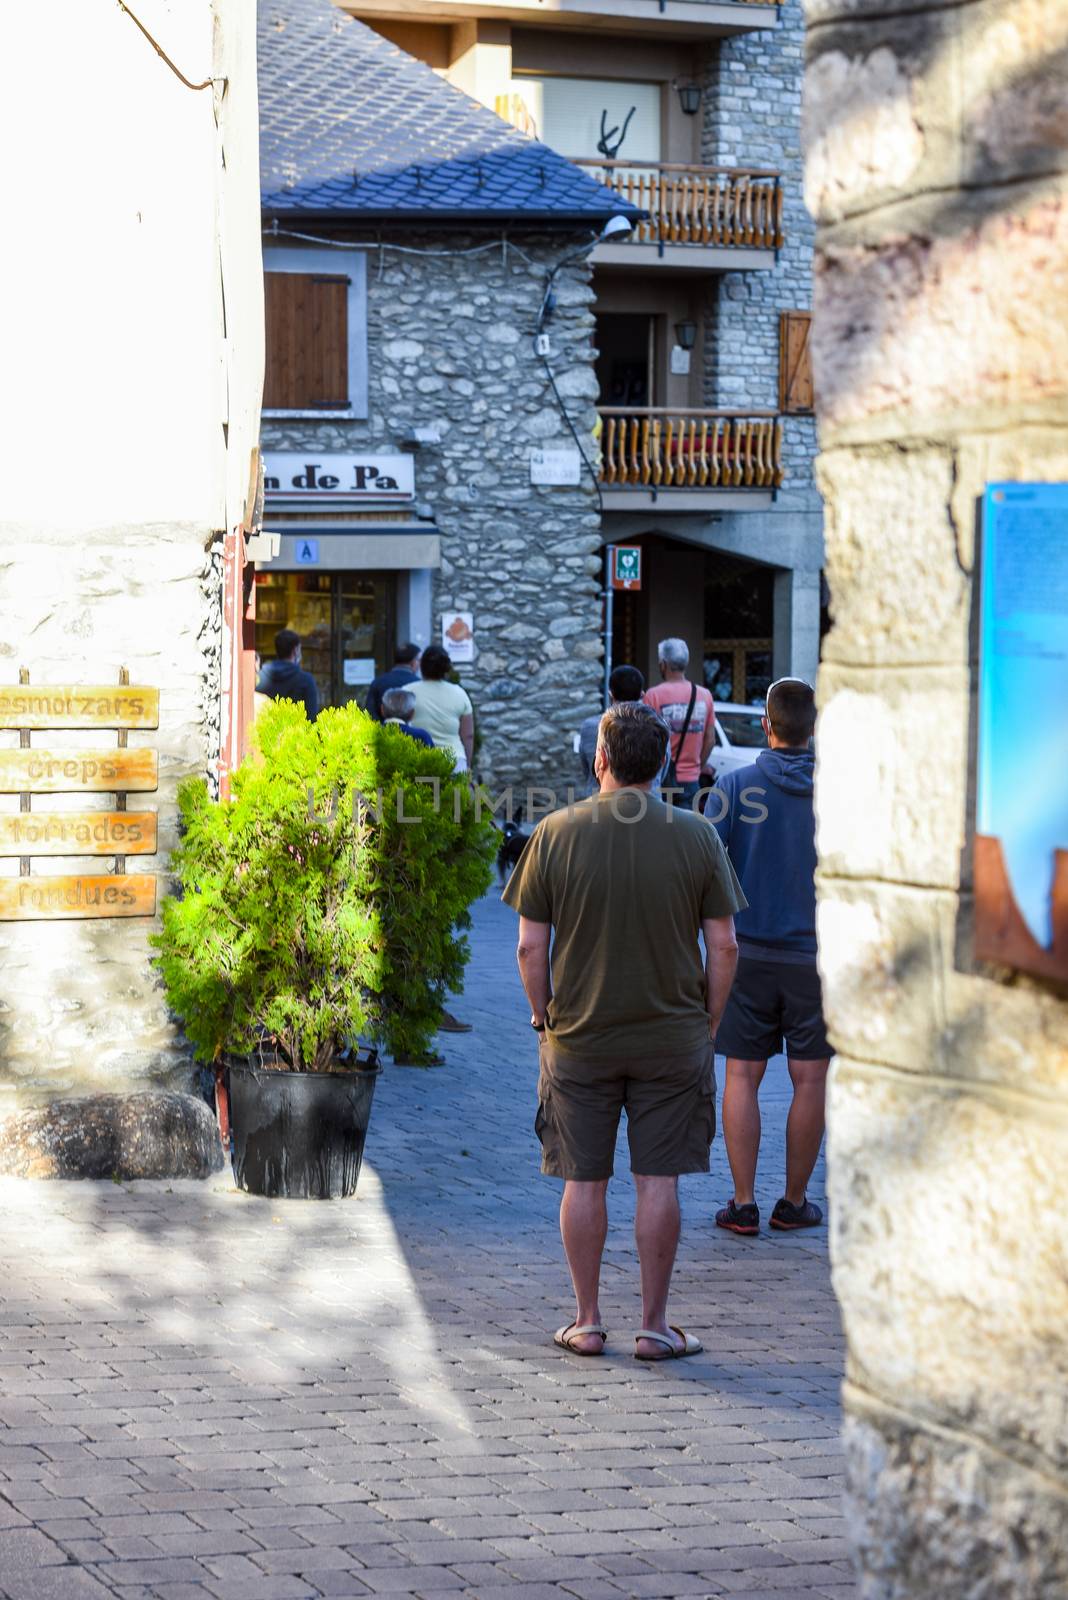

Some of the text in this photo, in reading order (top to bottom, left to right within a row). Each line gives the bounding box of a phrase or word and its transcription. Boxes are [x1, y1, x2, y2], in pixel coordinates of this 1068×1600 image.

[291, 465, 340, 490] de
[351, 466, 399, 490] Pa
[28, 758, 117, 784] creps
[9, 816, 143, 843] torrades
[17, 880, 137, 906] fondues
